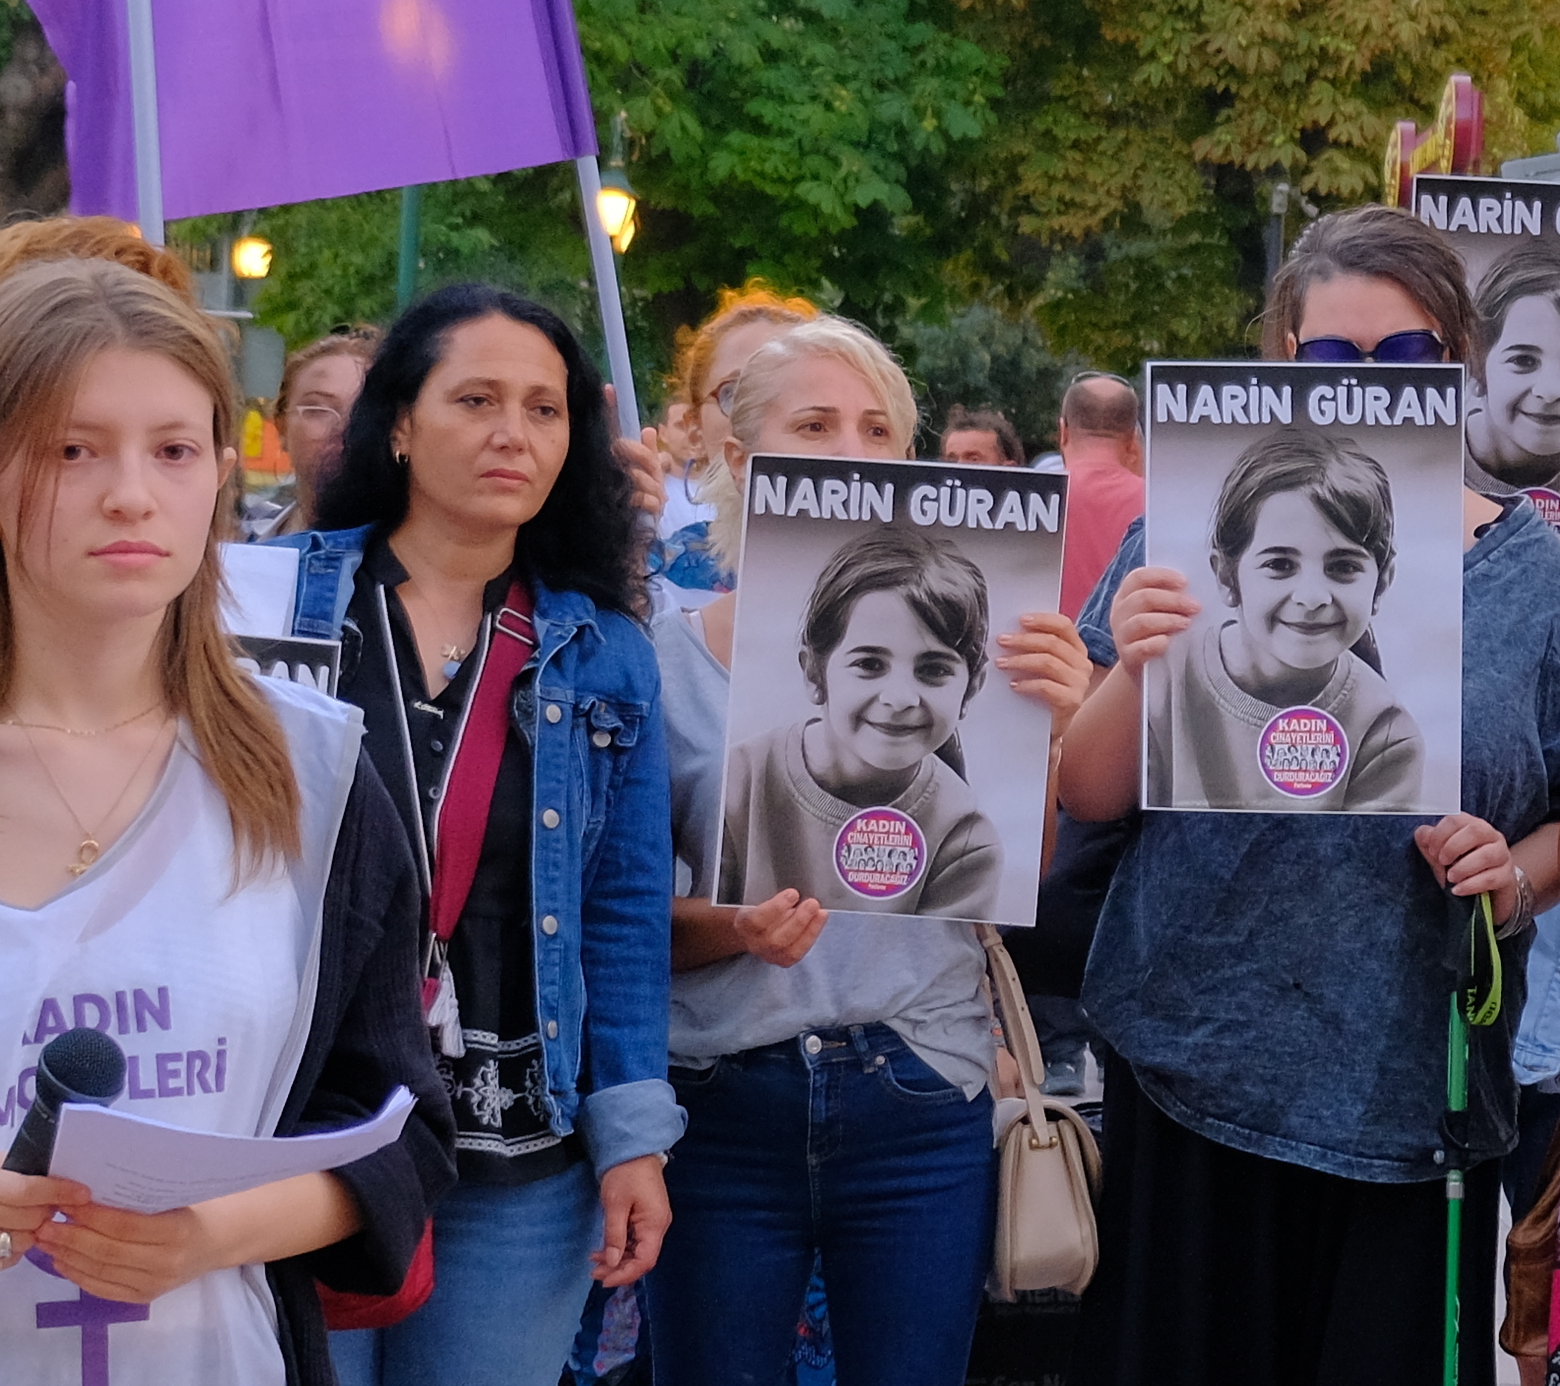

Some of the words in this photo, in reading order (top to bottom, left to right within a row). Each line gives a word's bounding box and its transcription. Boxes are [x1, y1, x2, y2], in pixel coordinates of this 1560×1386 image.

[1419, 191, 1542, 236] NARİN
[1155, 377, 1293, 425] NARİN
[1308, 379, 1458, 426] GÜRAN
[754, 472, 895, 524] NARİN
[910, 479, 1060, 533] GÜRAN
[1536, 499, 1560, 511] DIN
[1279, 718, 1327, 732] KADIN
[855, 818, 907, 834] KADIN
[22, 985, 172, 1046] ADIN
